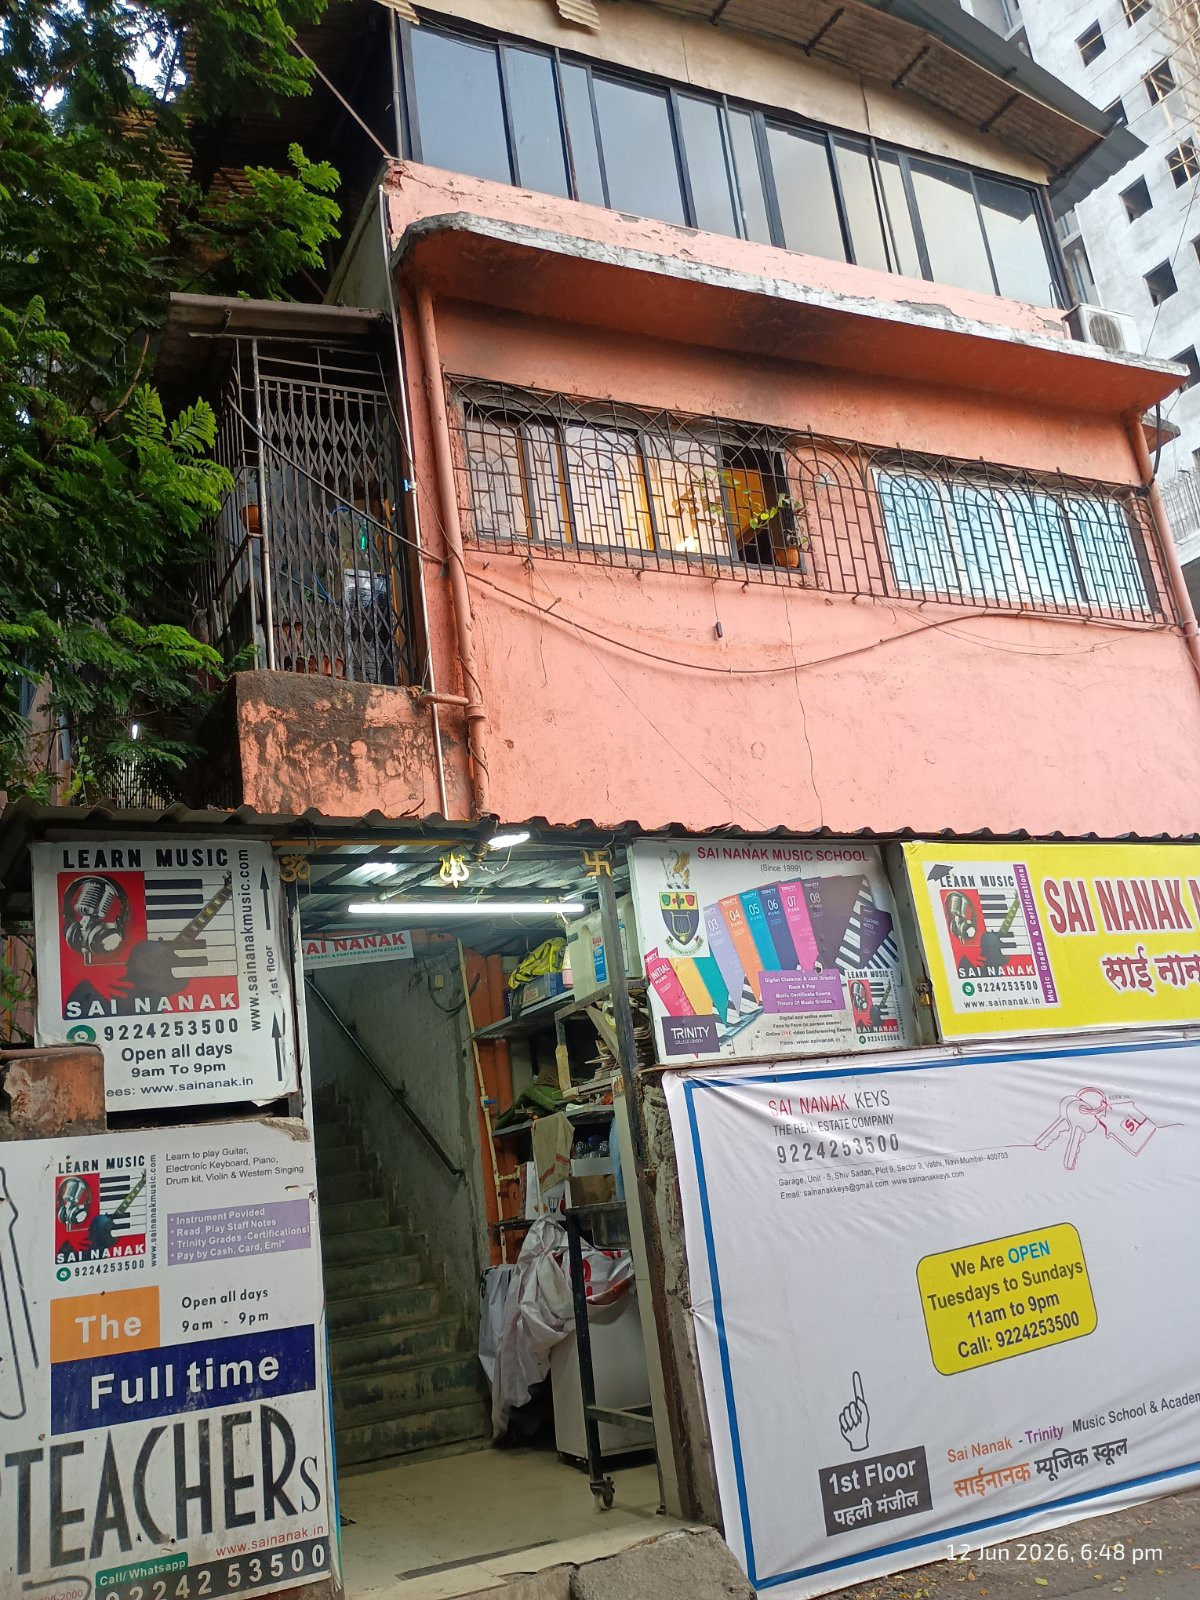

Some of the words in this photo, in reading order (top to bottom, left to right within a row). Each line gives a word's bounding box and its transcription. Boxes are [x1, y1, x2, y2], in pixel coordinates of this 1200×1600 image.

[63, 849, 142, 868] LEARN
[156, 848, 228, 867] MUSIC
[697, 847, 719, 859] SAI
[723, 848, 769, 860] NANAK
[772, 849, 813, 861] MUSIC
[816, 851, 870, 861] SCHOOL
[761, 864, 781, 872] (Since
[940, 876, 975, 887] LEARN
[980, 876, 1014, 887] MUSIC
[768, 899, 778, 911] 06
[787, 896, 796, 907] 07
[810, 893, 820, 903] 08
[1044, 880, 1096, 933] SAI
[1095, 880, 1192, 932] NANAK
[729, 909, 740, 921] 04
[749, 903, 759, 916] 05
[708, 919, 719, 931] 03
[238, 849, 261, 1031] www.sainanakmusic.com
[302, 941, 326, 955] AI
[334, 933, 405, 952] NANAK
[266, 946, 275, 972] floor
[1037, 942, 1047, 970] Grades
[650, 963, 670, 980] INITIAL
[959, 967, 981, 977] SAI
[988, 966, 1034, 975] NANAK
[1102, 946, 1154, 992] साई
[269, 978, 278, 995] 1st
[977, 981, 1038, 992] 9224253500
[1044, 977, 1054, 1001] Music
[67, 998, 117, 1018] SAI
[136, 993, 237, 1013] NANAK
[964, 998, 1040, 1008] www.sainanak.in
[104, 1018, 238, 1041] 9224253500
[671, 1027, 710, 1039] TRINITY
[121, 1045, 166, 1064] Open
[172, 1043, 191, 1059] all
[195, 1042, 233, 1058] days
[131, 1066, 164, 1078] 9am
[171, 1065, 188, 1075] To
[193, 1063, 226, 1075] 9pm
[106, 1087, 135, 1098] ees:
[141, 1078, 253, 1094] www.sainanak.in
[768, 1099, 792, 1116] SAI
[800, 1094, 849, 1114] NANAK
[855, 1090, 890, 1108] KEYS
[773, 1124, 791, 1136] THE
[795, 1122, 817, 1134] REAL
[819, 1119, 850, 1131] ESTATE
[852, 1114, 894, 1128] COMPANY
[166, 1153, 190, 1161] Learn
[203, 1150, 219, 1159] play
[777, 1134, 899, 1163] 9224253500
[59, 1160, 98, 1174] LEARN
[106, 1156, 144, 1169] MUSIC
[166, 1164, 207, 1173] Electronic
[210, 1159, 250, 1169] Keyboard,
[779, 1178, 806, 1186] Garage,
[807, 1175, 821, 1183] Unit
[851, 1169, 874, 1177] Sadan,
[897, 1163, 916, 1172] Sector
[166, 1177, 189, 1185] Drum
[239, 1169, 272, 1178] Western
[275, 1166, 303, 1174] Singing
[780, 1190, 801, 1199] Email:
[177, 1213, 226, 1224] Instrument
[229, 1208, 264, 1219] Povided
[206, 1226, 225, 1234] Play
[228, 1221, 248, 1230] Staff
[251, 1220, 276, 1228] Notes
[177, 1238, 206, 1248] Trinity
[209, 1234, 241, 1244] Grades
[57, 1251, 82, 1263] SAI
[91, 1244, 144, 1259] NANAK
[177, 1252, 194, 1261] Pay
[197, 1249, 208, 1258] by
[210, 1246, 236, 1256] Cash,
[238, 1244, 262, 1253] Card,
[951, 1260, 975, 1278] We
[980, 1255, 1005, 1271] Are
[1008, 1241, 1050, 1263] OPEN
[75, 1260, 144, 1277] 9224253500
[927, 1283, 1000, 1310] Tuesdays
[1003, 1278, 1018, 1291] to
[1022, 1262, 1083, 1286] Sundays
[181, 1295, 216, 1310] Open
[221, 1292, 236, 1305] all
[240, 1288, 268, 1302] days
[968, 1308, 1007, 1328] 11am
[1010, 1302, 1024, 1316] to
[1028, 1294, 1060, 1313] 9pm
[75, 1315, 142, 1343] The
[181, 1318, 213, 1332] 9am
[239, 1311, 269, 1328] 9pm
[958, 1336, 992, 1357] Call:
[996, 1311, 1079, 1347] 9224253500
[90, 1364, 174, 1410] Full
[187, 1356, 279, 1393] time
[947, 1449, 968, 1463] Sai
[972, 1437, 1012, 1458] Nanak
[1072, 1415, 1105, 1433] Music
[1108, 1403, 1147, 1424] School
[1149, 1401, 1158, 1414] &
[829, 1469, 860, 1494] 1st
[864, 1460, 915, 1487] Floor
[954, 1463, 1031, 1497] साईनानक
[1034, 1447, 1089, 1481] म्यूजिक
[1092, 1438, 1128, 1465] स्कूल
[833, 1498, 872, 1525] पहली
[876, 1489, 918, 1513] मंजील
[216, 1524, 325, 1557] www.sainanak.in
[100, 1571, 125, 1586] Call/
[128, 1558, 186, 1580] Whatsapp
